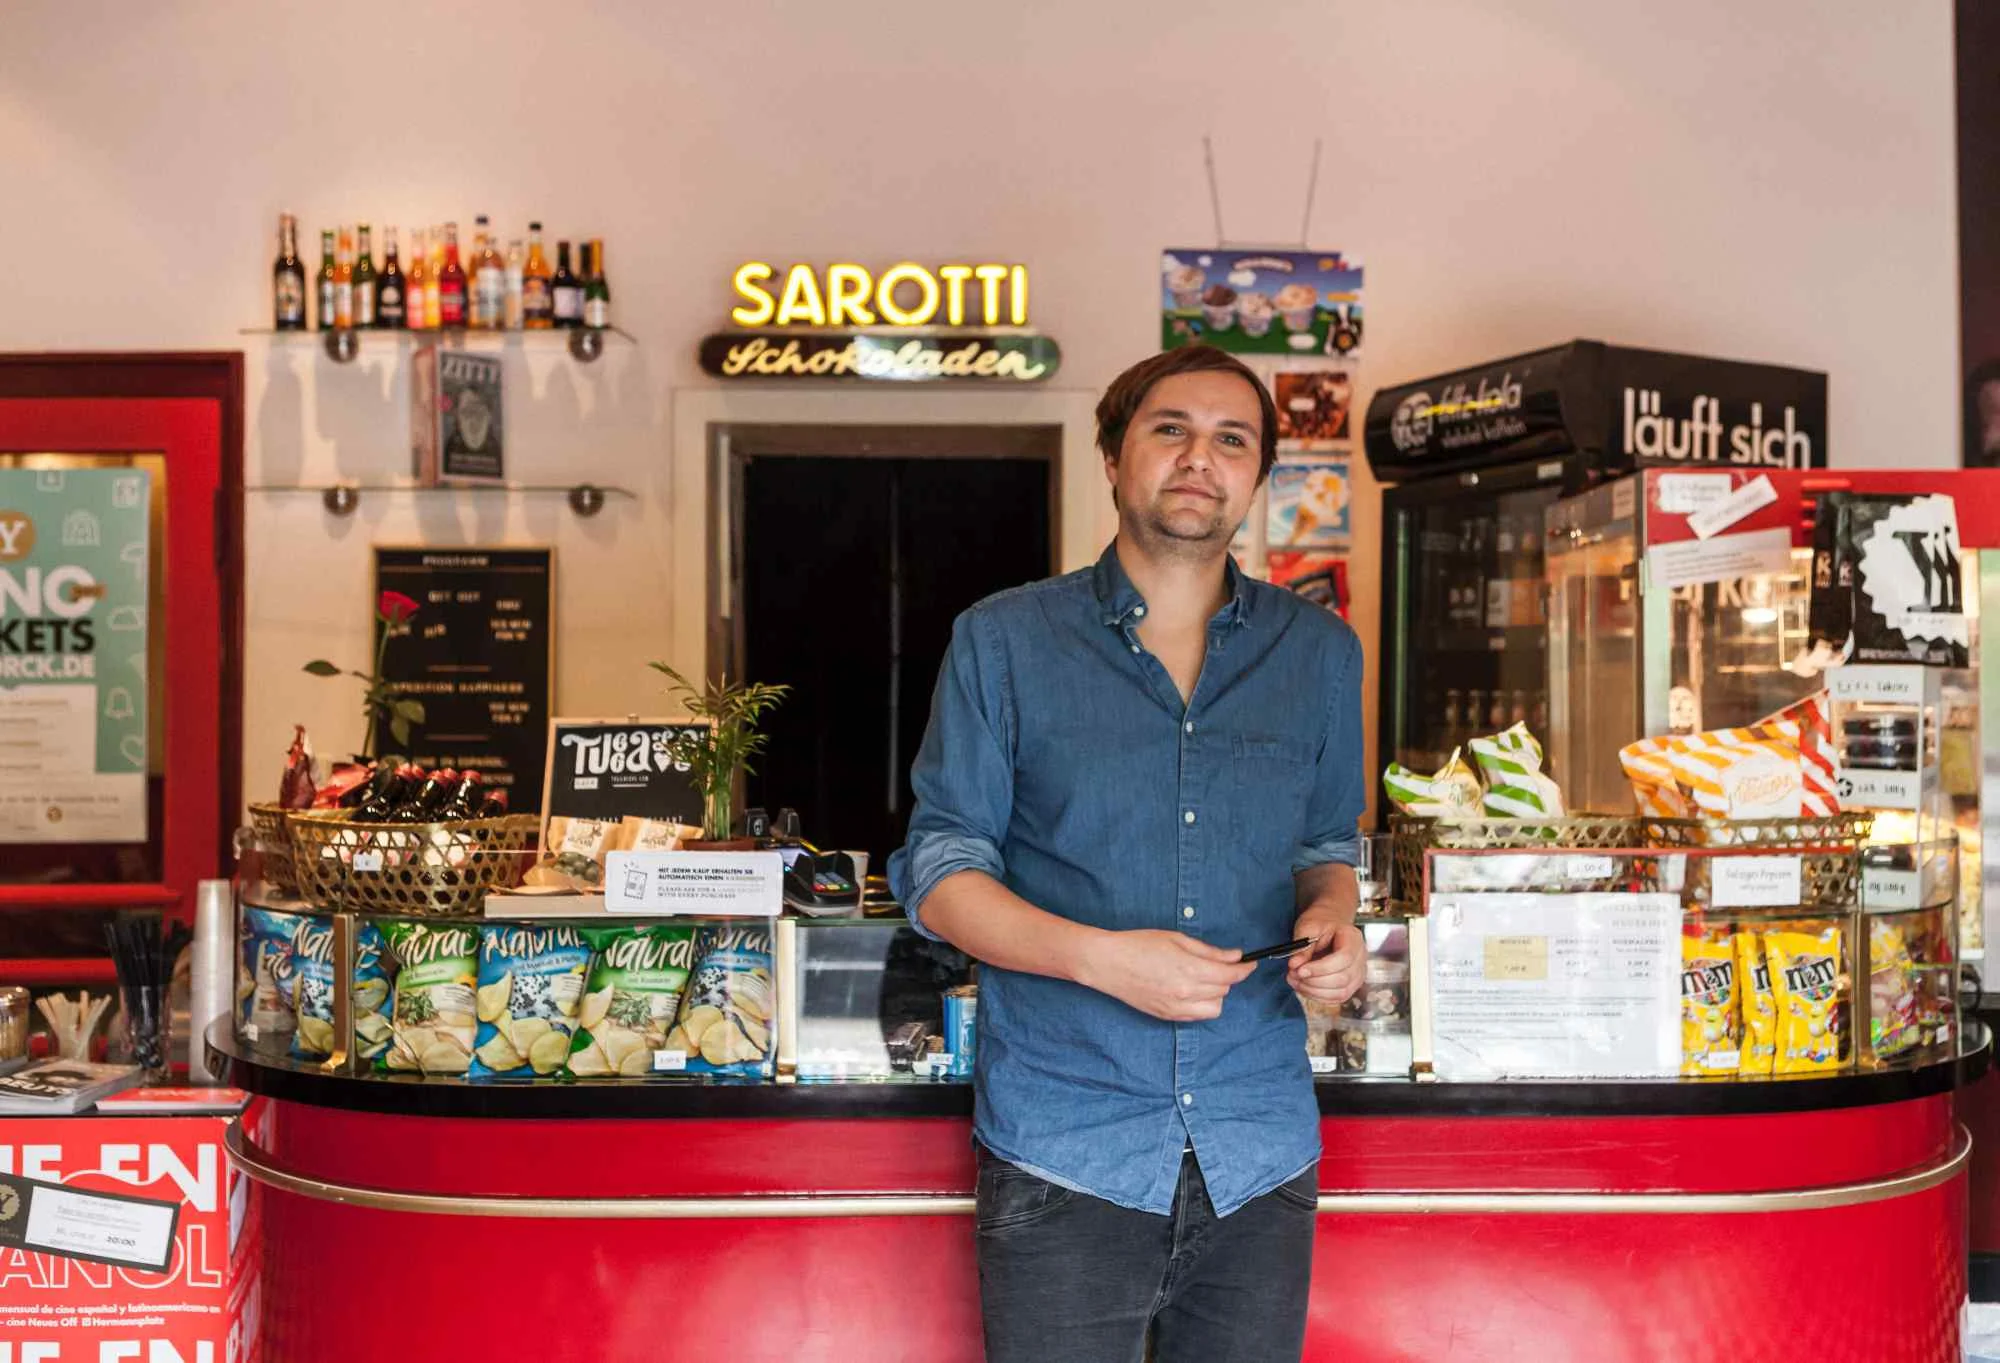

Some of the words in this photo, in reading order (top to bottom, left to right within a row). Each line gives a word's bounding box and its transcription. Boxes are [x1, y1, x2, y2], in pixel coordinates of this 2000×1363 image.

[731, 262, 1029, 327] SAROTTI
[721, 336, 1046, 380] Schokoladen
[1624, 386, 1724, 461] läuft
[1729, 402, 1812, 469] sich
[605, 927, 697, 972] Natural
[0, 1145, 62, 1186] E
[101, 1144, 216, 1213] EN
[6, 1318, 26, 1328] cine
[28, 1318, 58, 1328] Neues
[60, 1317, 77, 1328] Off
[41, 1304, 53, 1314] de
[55, 1303, 75, 1314] cine
[77, 1303, 118, 1317] español
[119, 1305, 126, 1316] y
